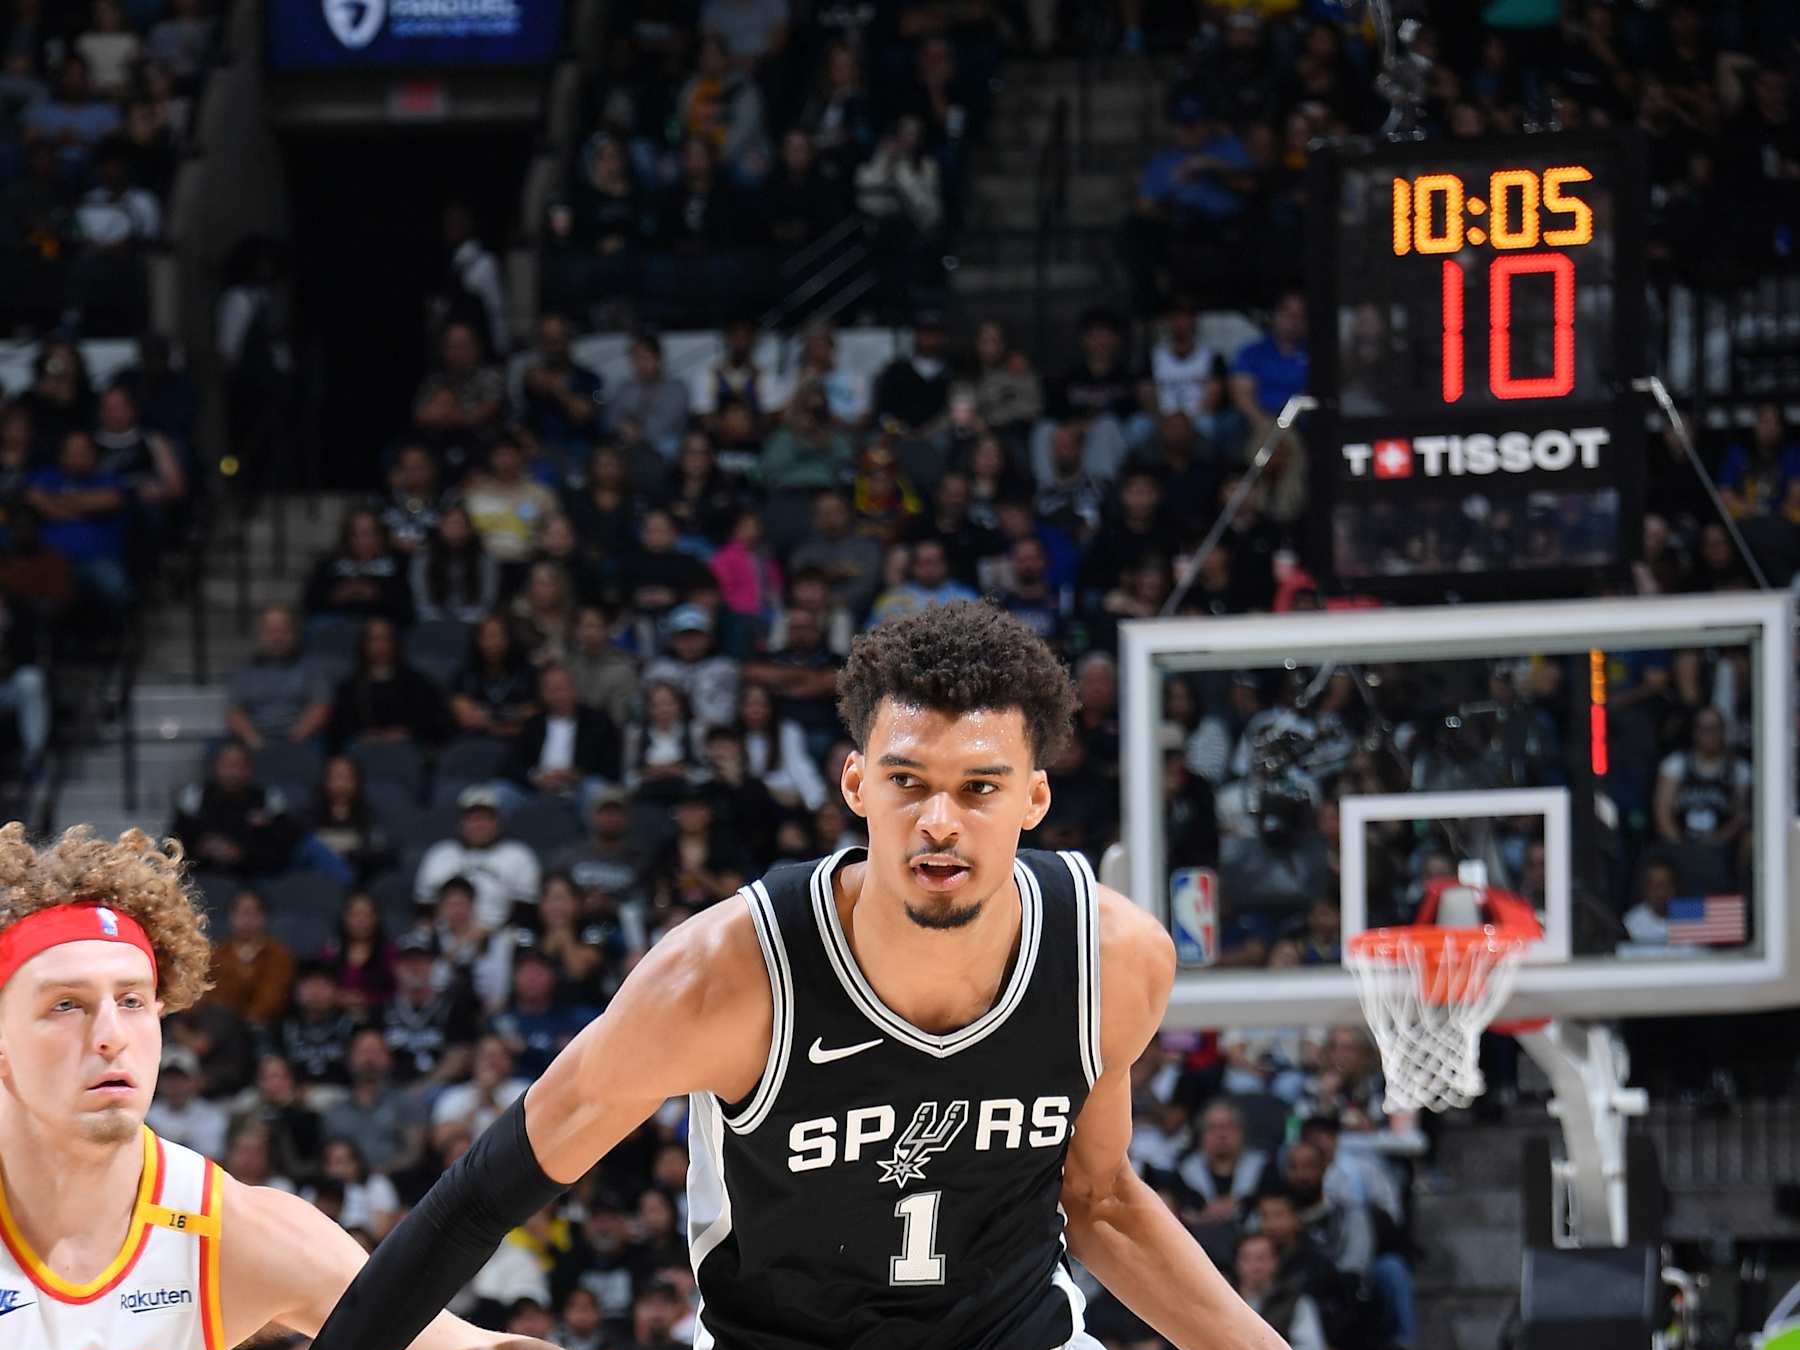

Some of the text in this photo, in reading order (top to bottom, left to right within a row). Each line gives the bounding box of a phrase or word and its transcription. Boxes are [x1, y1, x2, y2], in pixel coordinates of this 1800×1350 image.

[1392, 165, 1594, 256] 10:05
[1442, 252, 1576, 404] 10
[1413, 426, 1611, 476] TISSOT
[787, 1096, 1071, 1190] SPURS
[168, 1213, 188, 1229] 16
[889, 1189, 947, 1286] 1
[120, 1289, 193, 1311] Rakuten
